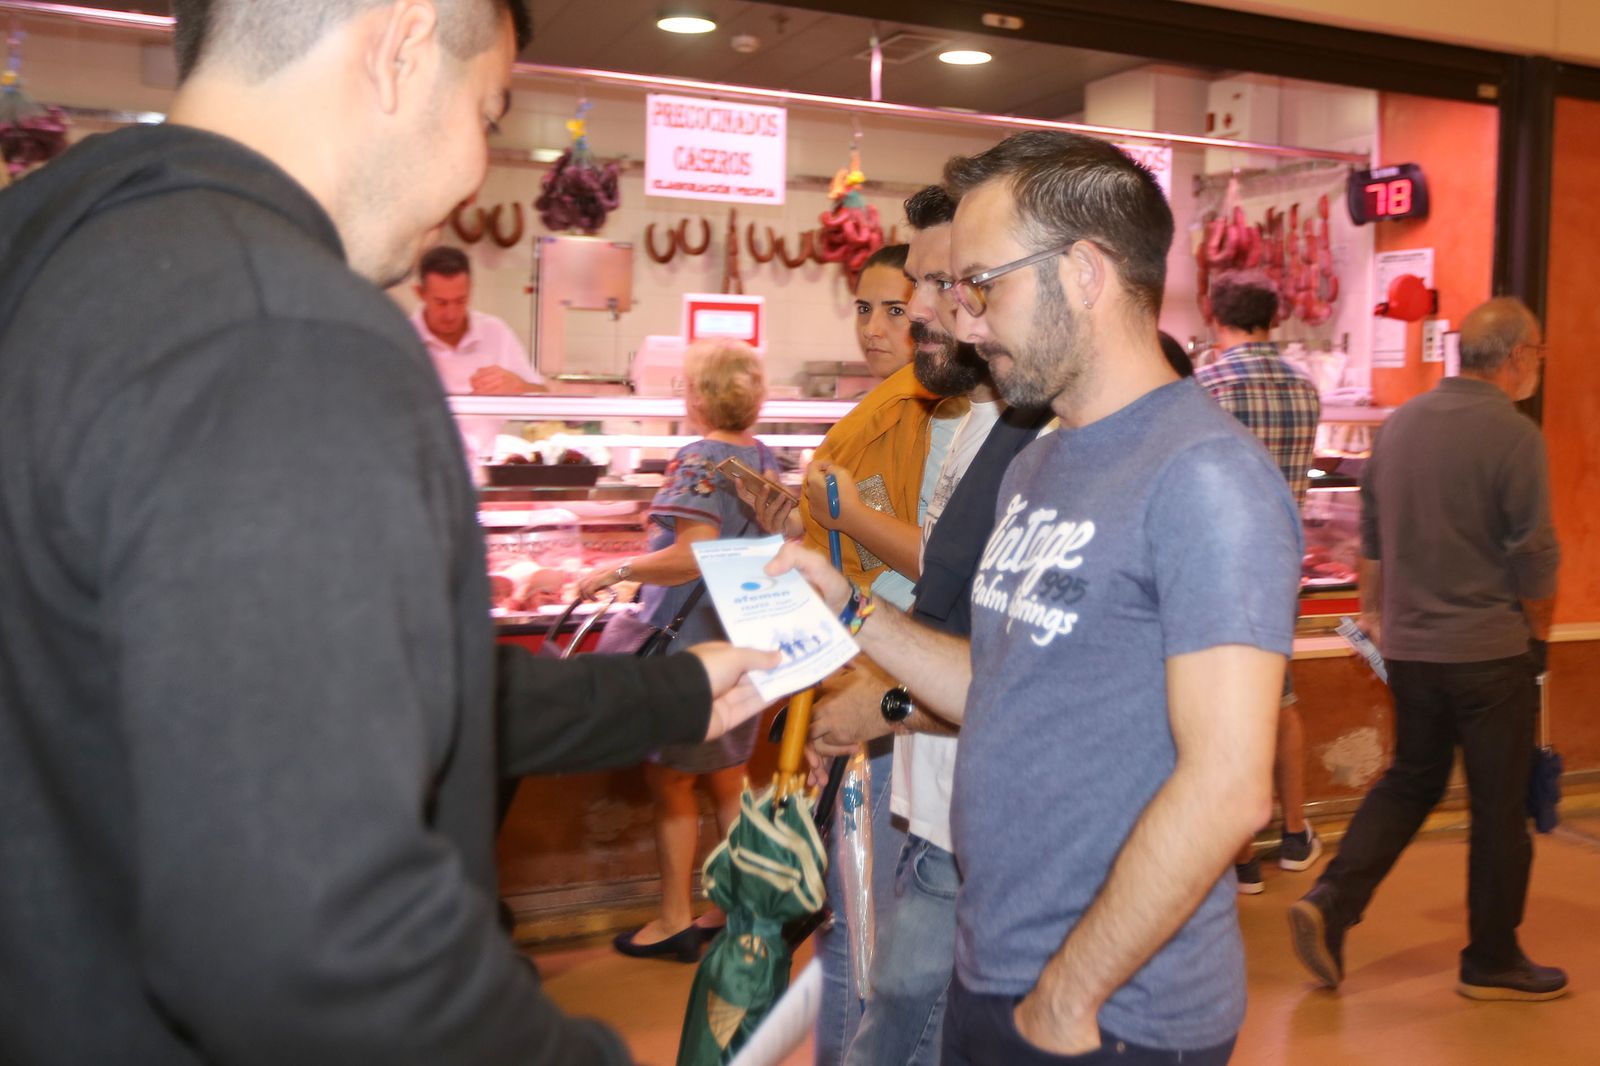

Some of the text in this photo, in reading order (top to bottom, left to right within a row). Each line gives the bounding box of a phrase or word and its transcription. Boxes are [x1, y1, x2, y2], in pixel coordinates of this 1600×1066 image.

[653, 101, 778, 137] PRECOCINADOS
[673, 146, 752, 175] CASEROS
[1364, 178, 1413, 216] 78
[971, 573, 1009, 613] Palm
